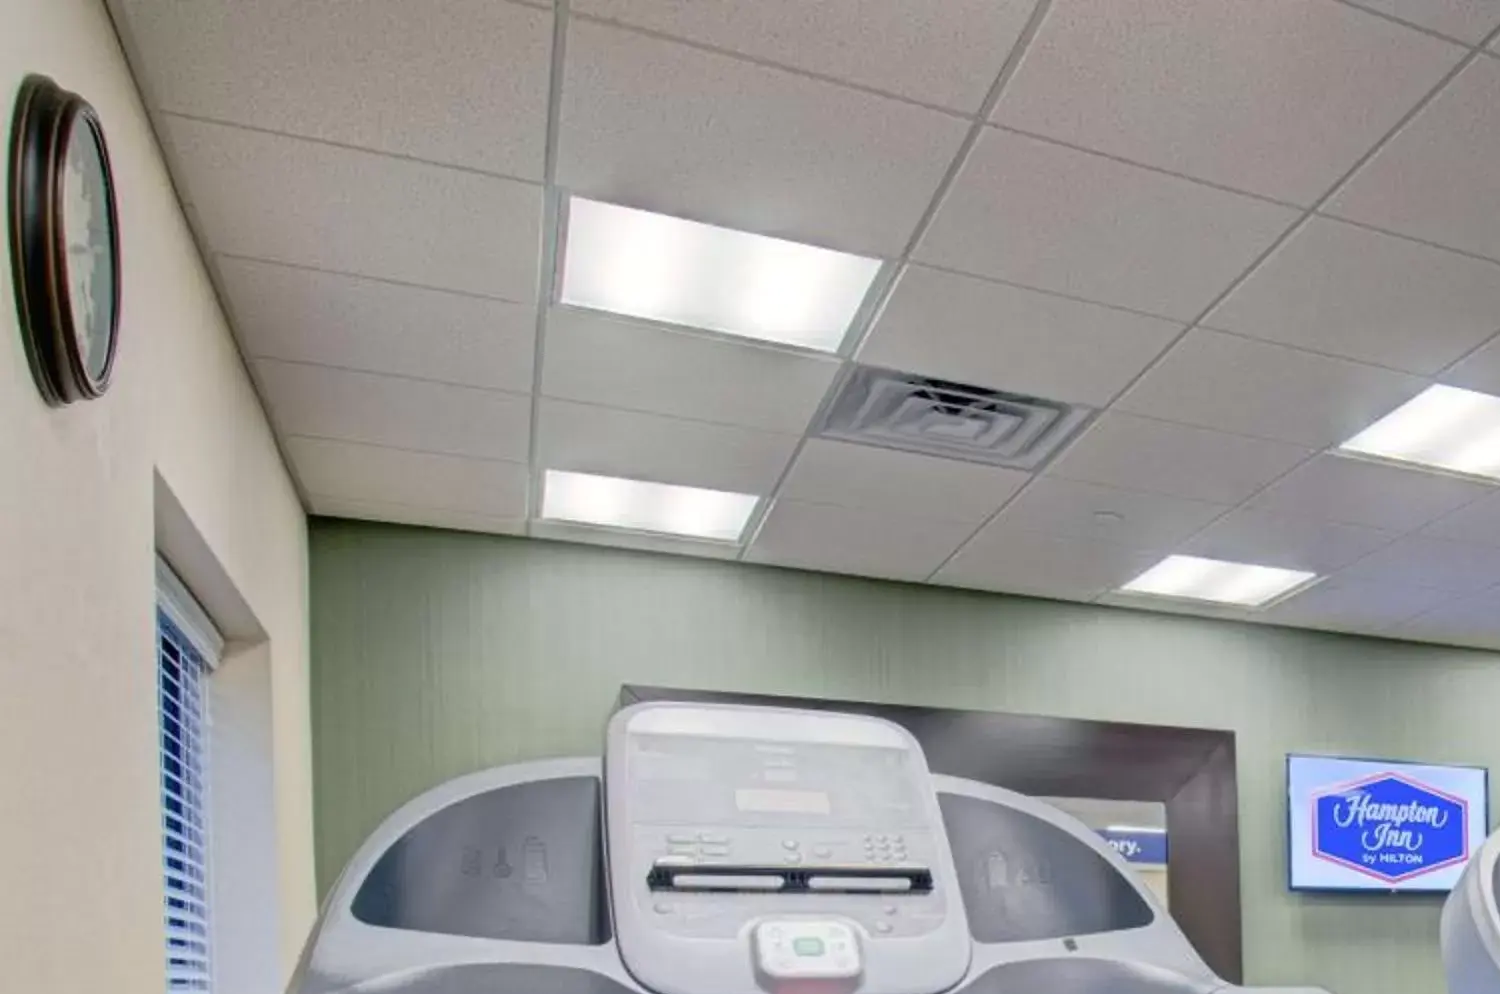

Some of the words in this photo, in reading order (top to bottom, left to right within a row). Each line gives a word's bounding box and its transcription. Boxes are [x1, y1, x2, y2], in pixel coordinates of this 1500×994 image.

[1334, 794, 1448, 828] Hampton
[1361, 823, 1423, 851] Inn
[1380, 853, 1424, 864] HILTON
